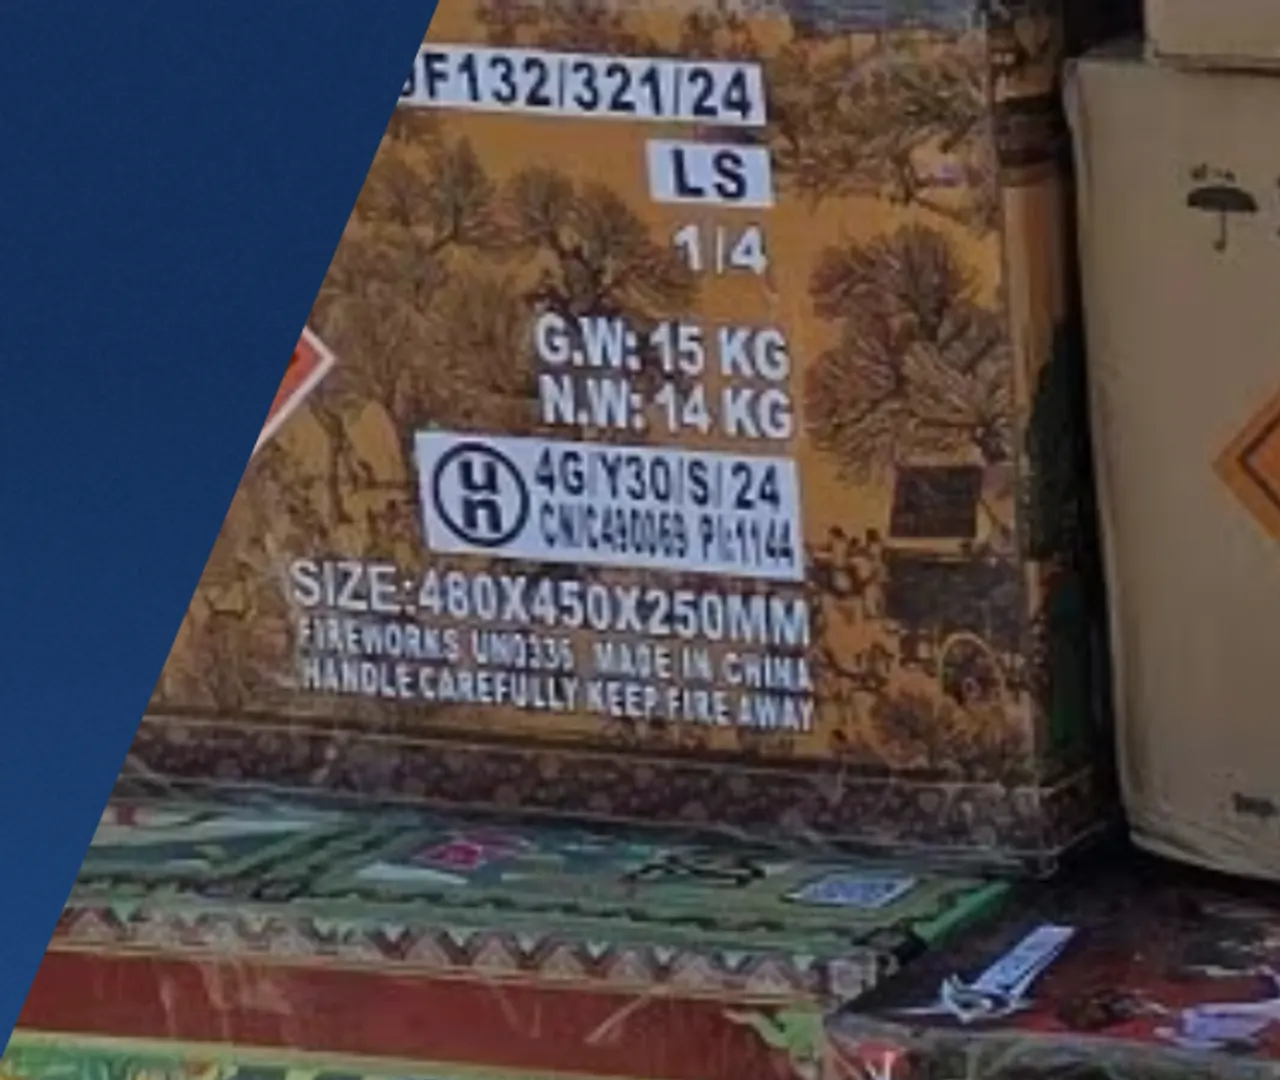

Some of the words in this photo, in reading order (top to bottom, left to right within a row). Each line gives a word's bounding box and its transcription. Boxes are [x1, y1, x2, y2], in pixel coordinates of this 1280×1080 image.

[671, 149, 748, 199] LS
[674, 222, 768, 275] 1/4
[649, 320, 705, 376] 15
[717, 325, 791, 381] KG
[655, 382, 711, 434] 14
[722, 387, 793, 439] KG
